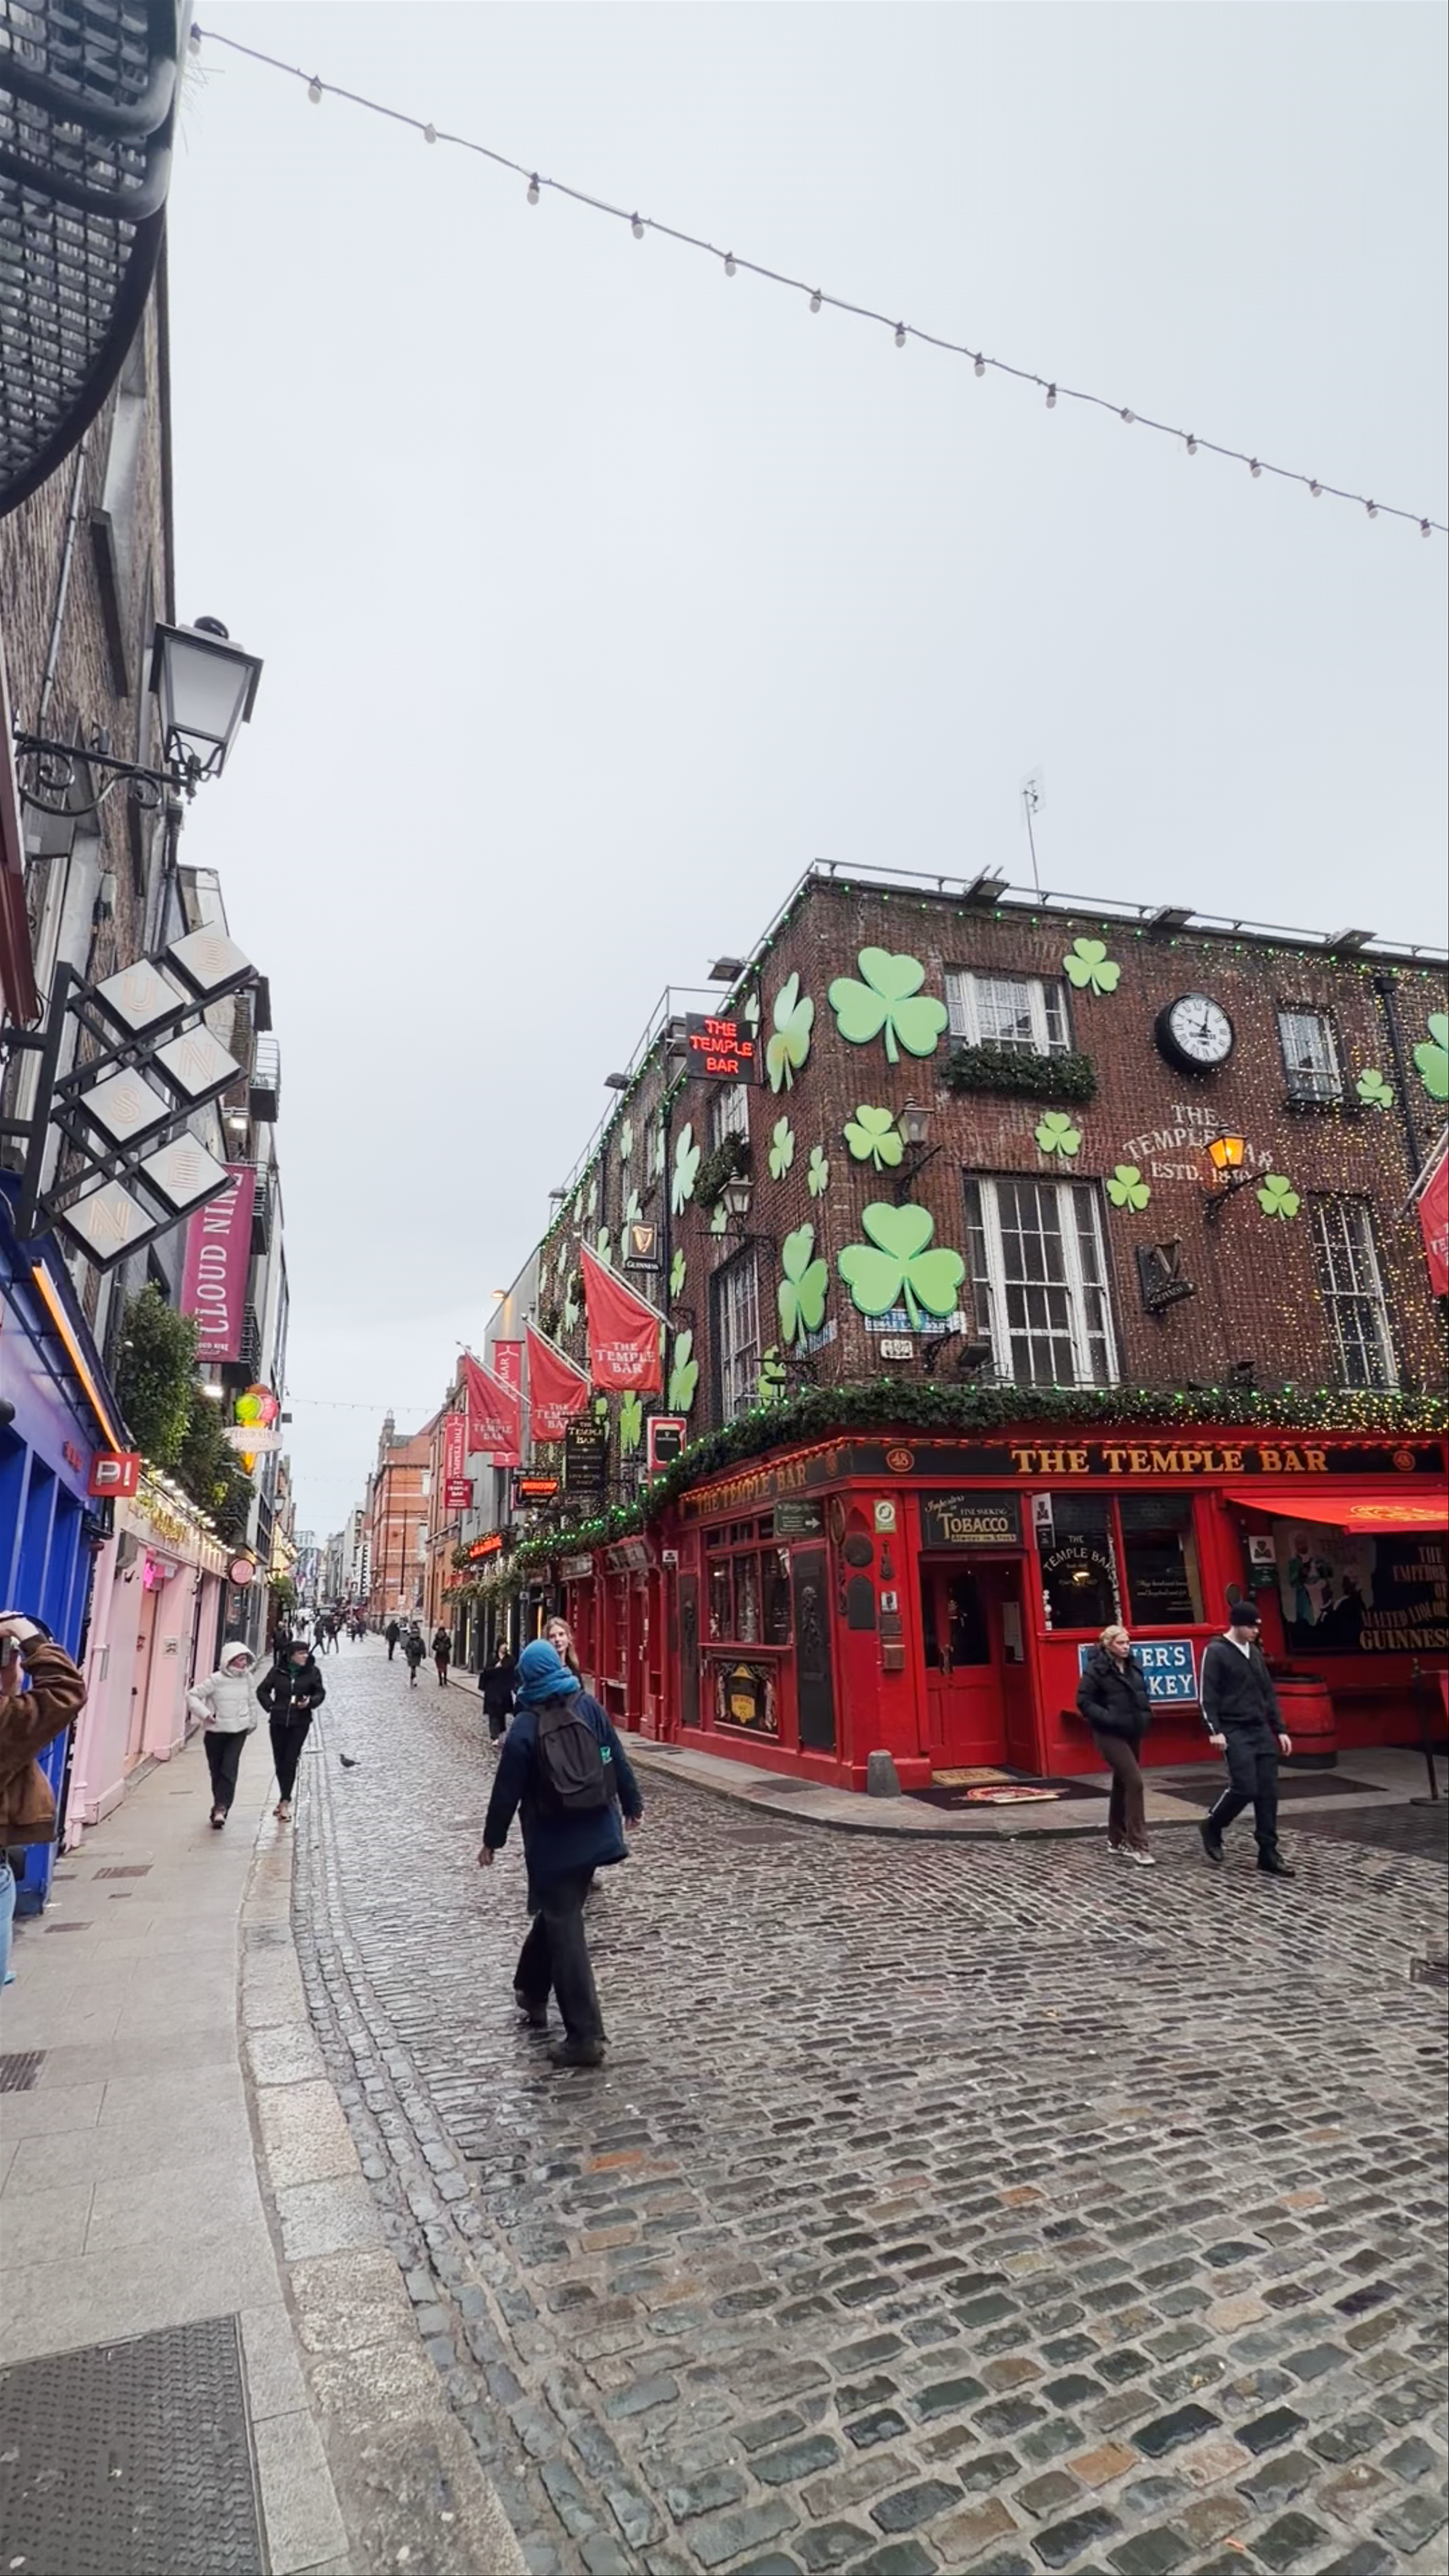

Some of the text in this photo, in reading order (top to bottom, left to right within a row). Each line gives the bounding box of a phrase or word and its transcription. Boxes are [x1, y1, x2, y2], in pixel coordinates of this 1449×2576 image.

[705, 1020, 737, 1037] THE
[690, 1035, 752, 1056] TEMPLE
[707, 1057, 738, 1073] BAR
[1171, 1105, 1220, 1126] THE
[1244, 1143, 1274, 1172] AR
[1151, 1161, 1204, 1181] ESTD.
[195, 1245, 229, 1333] CLOUD
[595, 1350, 655, 1363] TEMPLE
[612, 1342, 638, 1351] THE
[611, 1361, 643, 1373] BAR
[1012, 1450, 1089, 1473] THE
[1102, 1449, 1244, 1473] TEMPLE
[1259, 1449, 1329, 1472] BAR
[697, 1493, 718, 1515] THE
[721, 1474, 771, 1509] TEMPLE
[777, 1463, 807, 1491] BAR
[938, 1513, 1009, 1539] TOBACCO
[1043, 1548, 1088, 1572] TEMPLE
[1360, 1629, 1448, 1650] GUINNES
